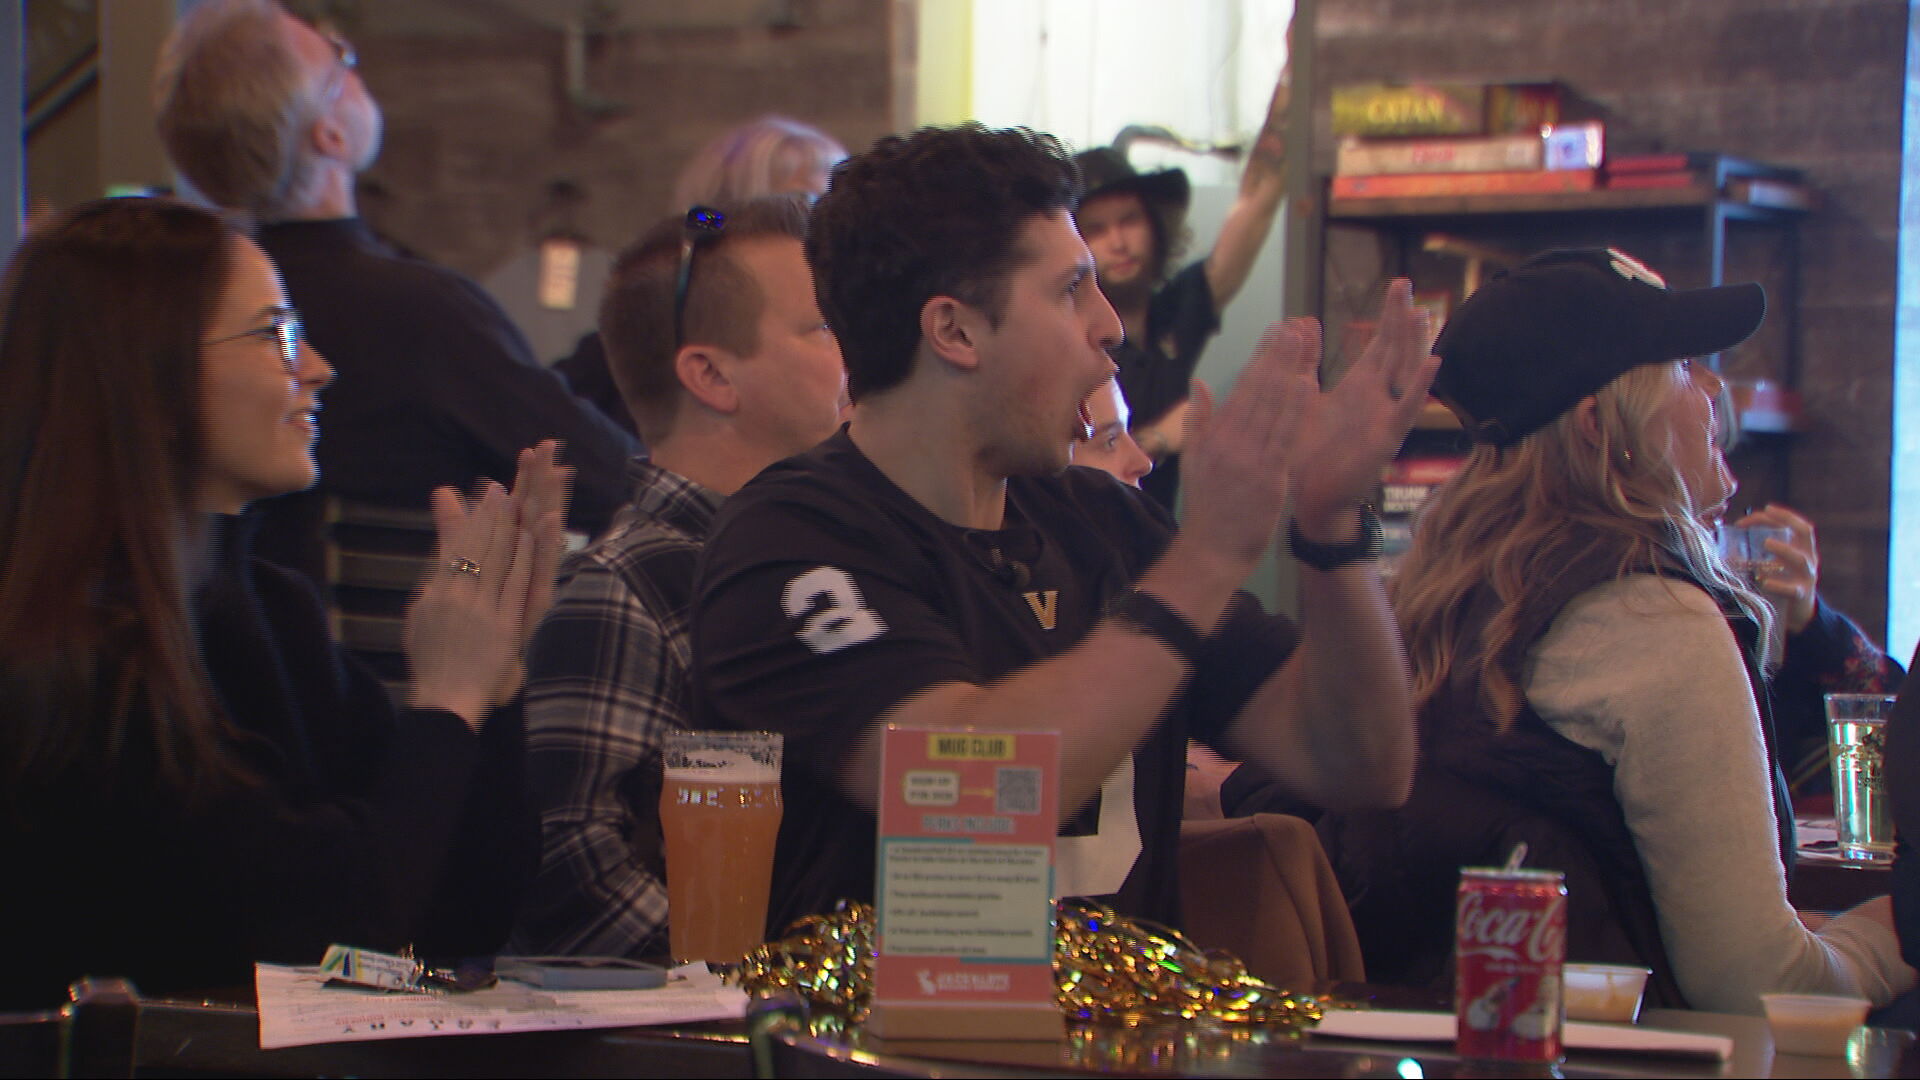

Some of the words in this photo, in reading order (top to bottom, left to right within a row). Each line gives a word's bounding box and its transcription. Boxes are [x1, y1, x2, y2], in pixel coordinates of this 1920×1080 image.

[1367, 93, 1445, 124] CATAN
[1023, 590, 1060, 630] V
[937, 738, 967, 756] MUG
[970, 739, 1007, 757] CLUB
